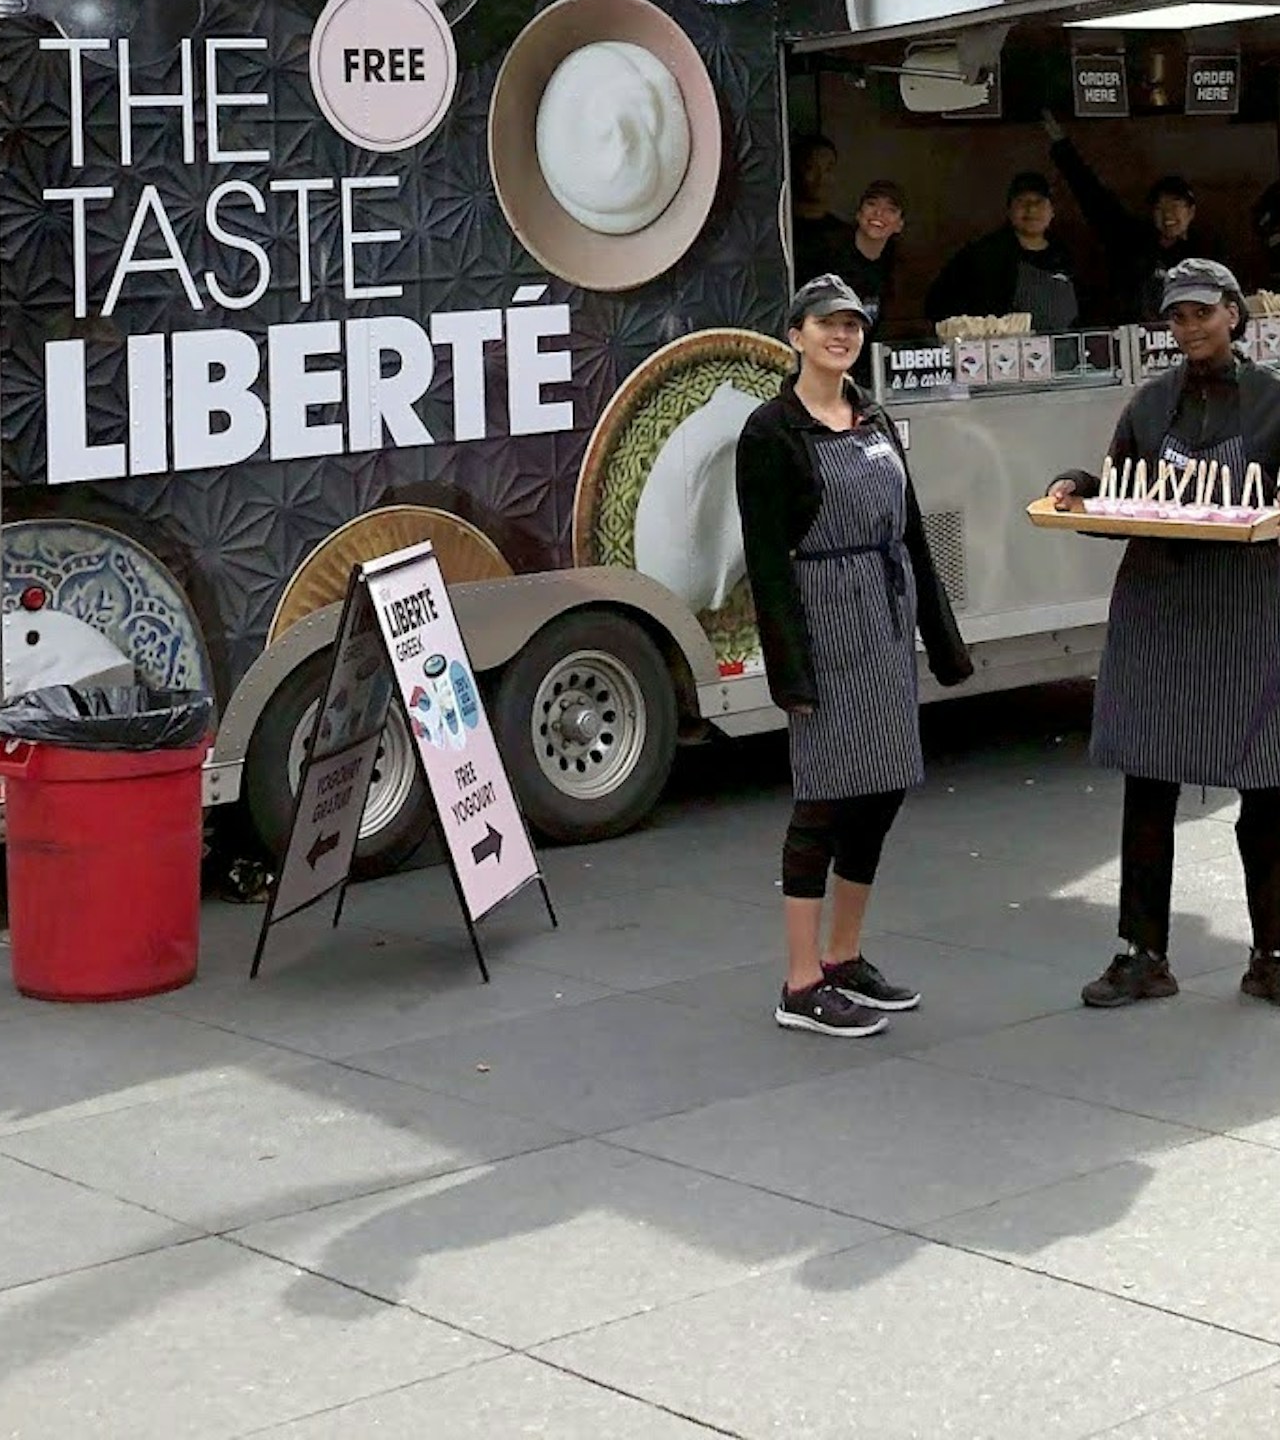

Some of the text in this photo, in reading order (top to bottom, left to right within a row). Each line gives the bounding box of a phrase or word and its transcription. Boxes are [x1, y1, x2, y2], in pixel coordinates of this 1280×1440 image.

[343, 46, 426, 83] FREE
[1078, 71, 1120, 86] ORDER
[1193, 70, 1234, 85] ORDER
[38, 37, 270, 167] THE
[1084, 88, 1117, 102] HERE
[1196, 87, 1229, 101] HERE
[43, 175, 404, 319] TASTE
[890, 346, 953, 371] LIBERTÉ
[44, 285, 574, 484] LIBERTÉ
[904, 371, 918, 389] la
[383, 582, 440, 639] LIBERTÉ
[395, 634, 426, 662] GREEK
[454, 761, 478, 791] FREE
[450, 781, 498, 826] YOGOURT
